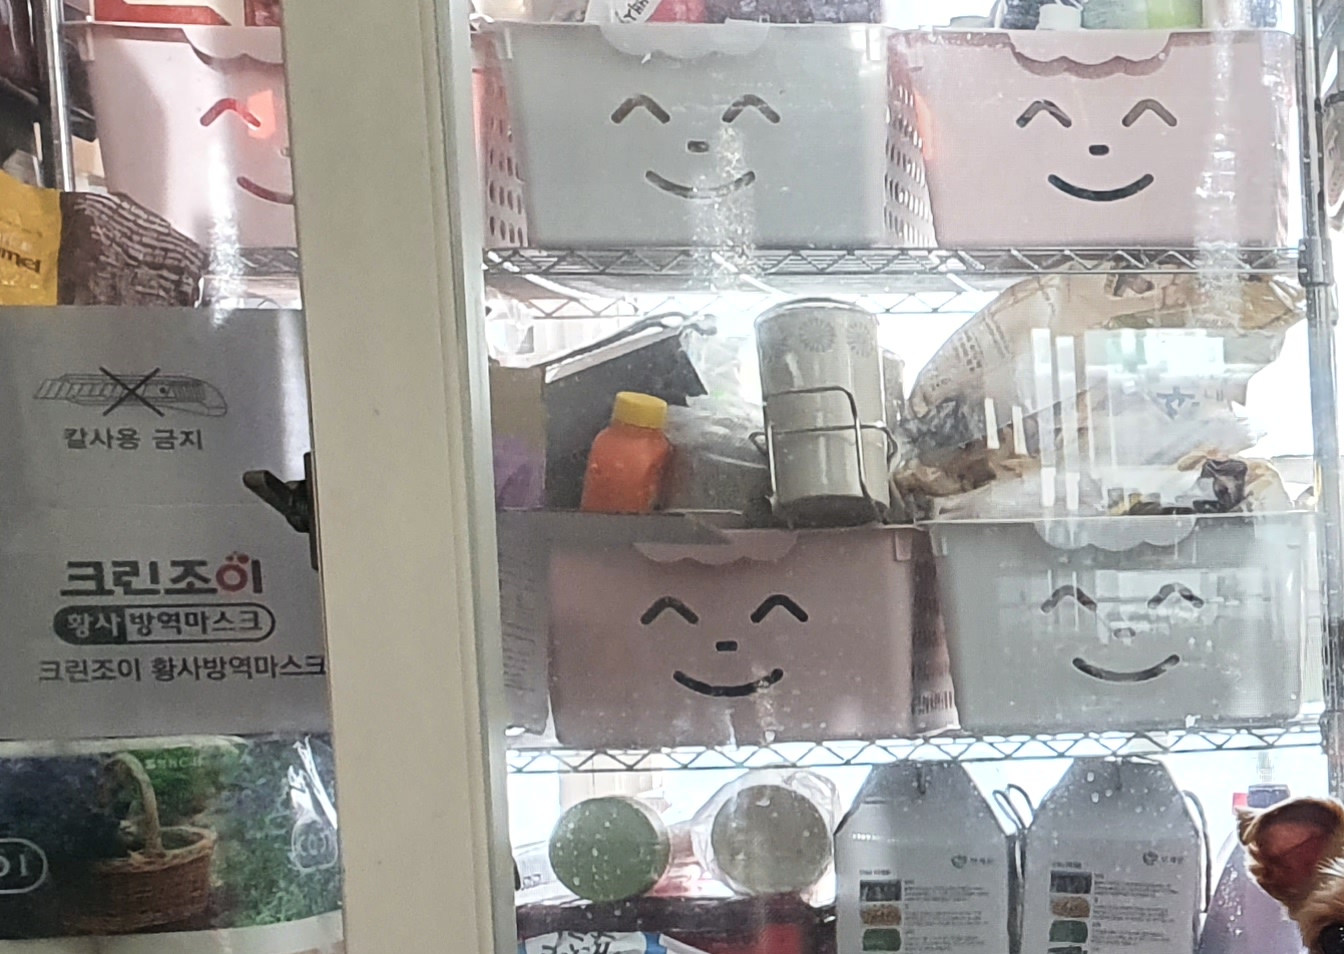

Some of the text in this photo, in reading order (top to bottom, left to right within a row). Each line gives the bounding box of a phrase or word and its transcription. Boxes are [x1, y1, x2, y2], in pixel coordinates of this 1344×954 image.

[64, 427, 204, 450] 칼사용 금지
[59, 554, 264, 596] 크린조이
[66, 609, 264, 638] 황사 방역마스크
[38, 654, 327, 684] 크린조이 황사방역마스크
